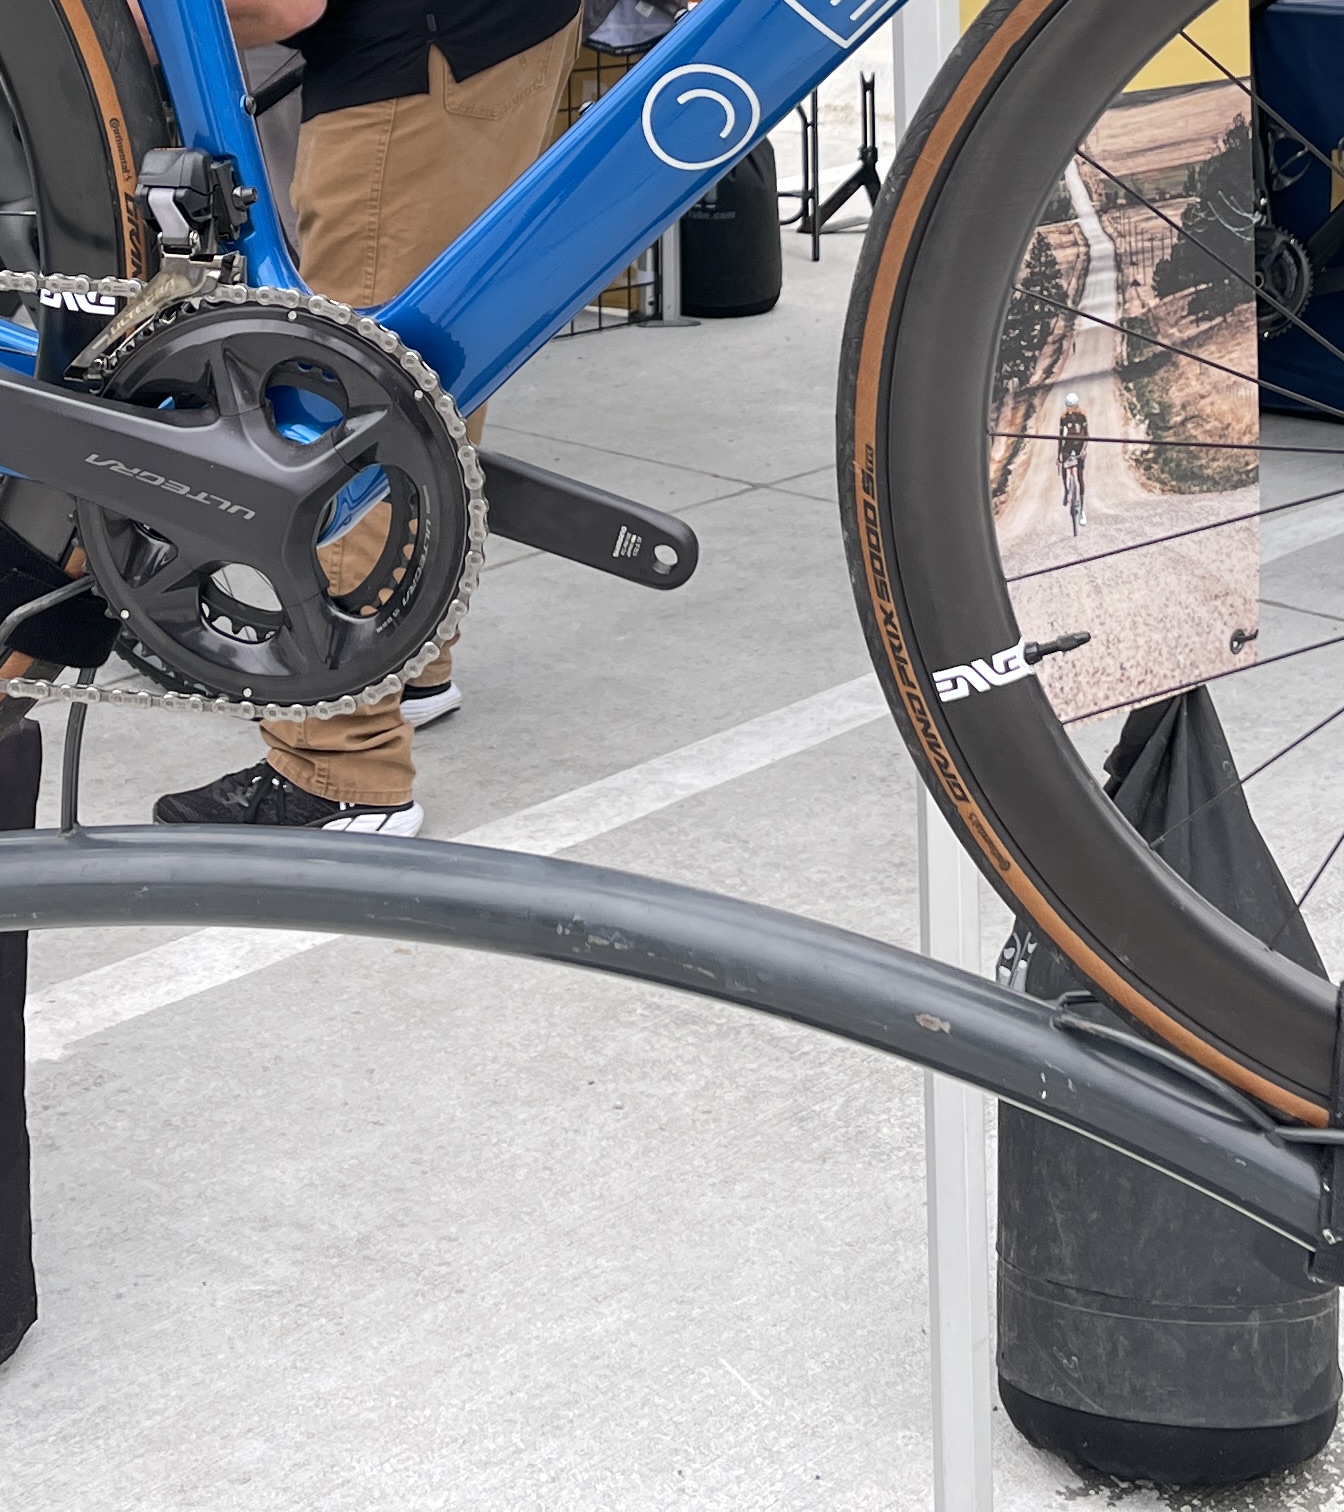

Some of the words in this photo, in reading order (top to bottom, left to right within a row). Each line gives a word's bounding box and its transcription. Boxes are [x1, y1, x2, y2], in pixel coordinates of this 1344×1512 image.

[124, 192, 143, 279] GRAN
[84, 453, 256, 521] ULTEGRA
[863, 498, 892, 604] 5000
[879, 604, 917, 690] PRIX
[907, 691, 971, 804] GRAND
